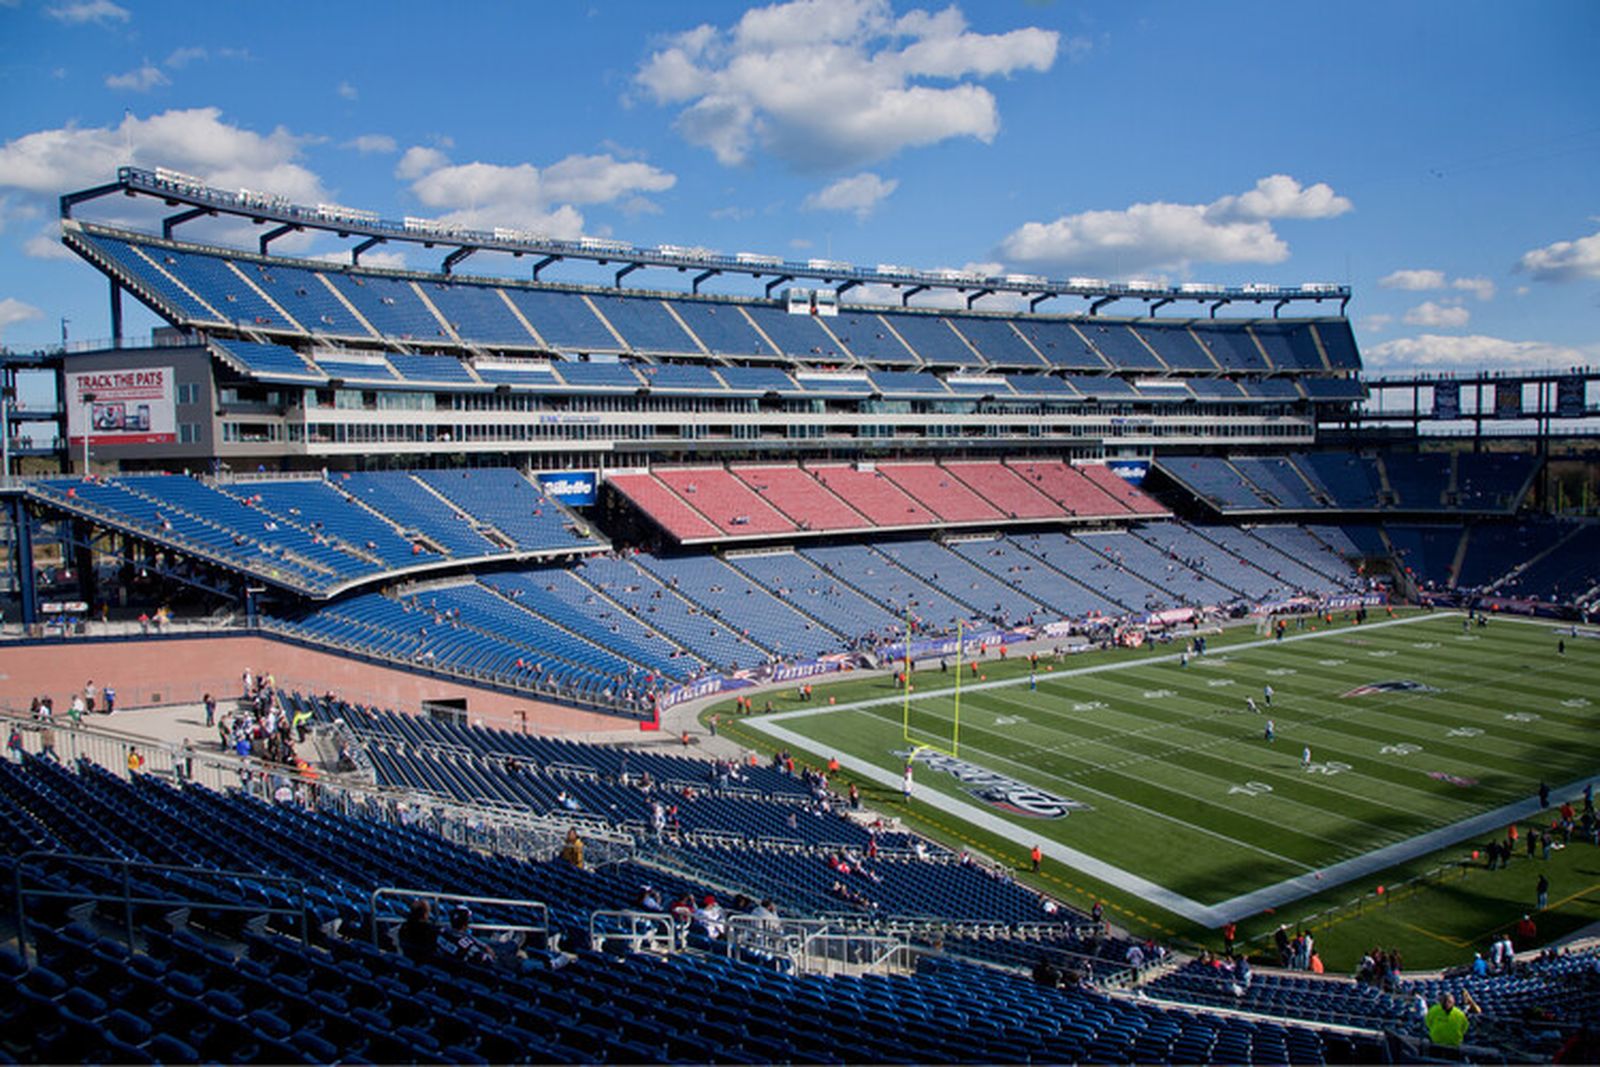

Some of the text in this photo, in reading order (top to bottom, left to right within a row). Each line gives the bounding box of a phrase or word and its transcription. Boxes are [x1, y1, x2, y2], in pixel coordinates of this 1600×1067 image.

[77, 371, 163, 388] TRACK THE PATS
[545, 480, 592, 495] Gillette
[777, 663, 826, 680] PATRIOTS
[1228, 780, 1274, 797] 10
